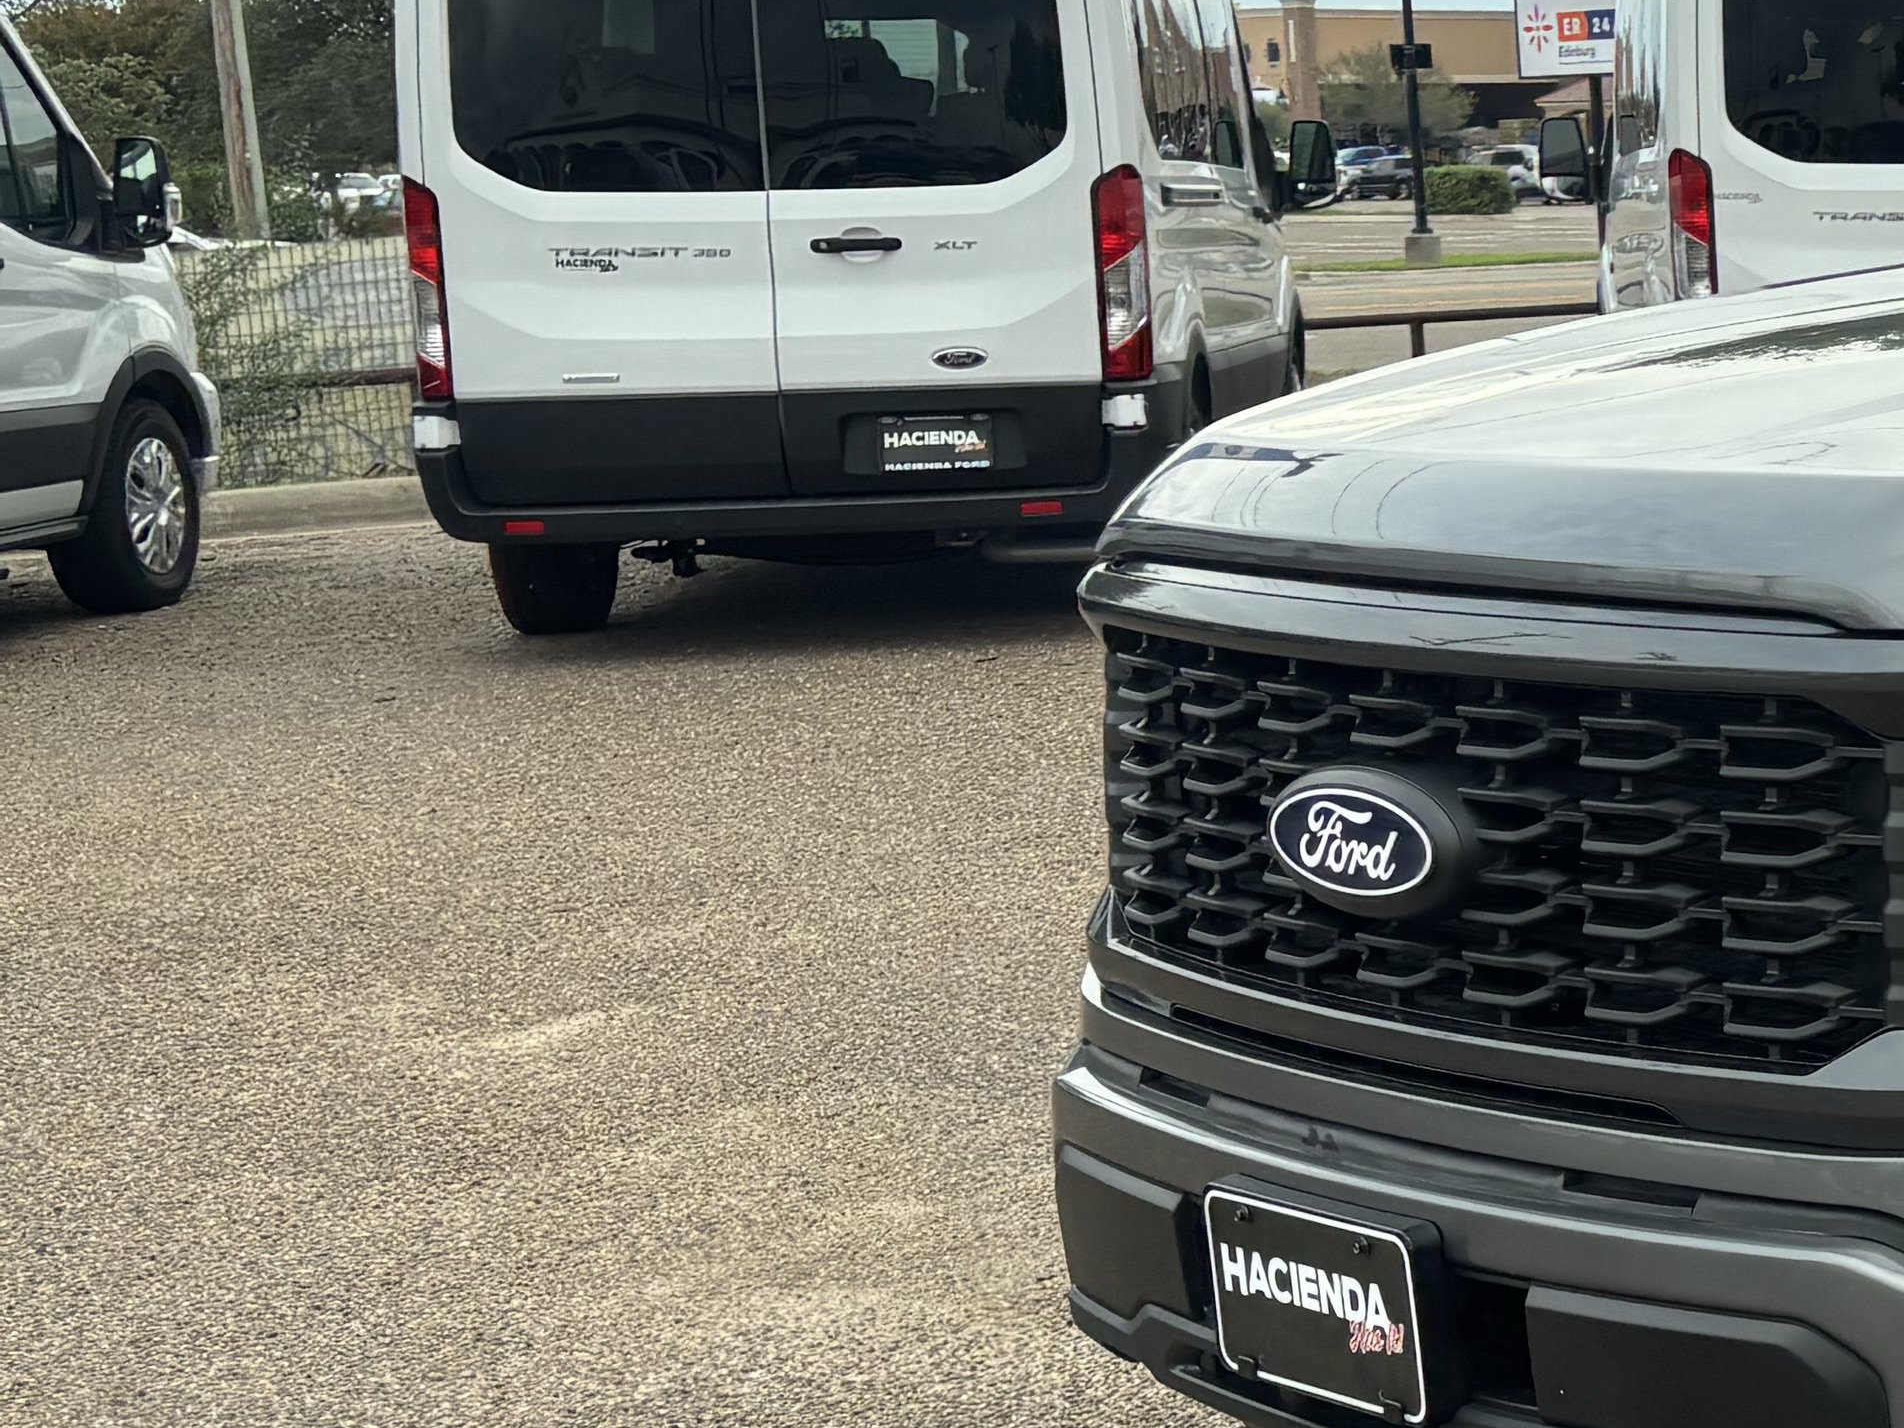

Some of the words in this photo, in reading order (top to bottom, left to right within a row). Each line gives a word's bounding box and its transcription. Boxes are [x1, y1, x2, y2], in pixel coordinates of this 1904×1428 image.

[1562, 17, 1582, 36] ER
[1592, 16, 1611, 34] 24
[548, 246, 689, 258] TRANSIT
[933, 240, 979, 251] XLT
[555, 258, 615, 269] HACIENDA
[883, 430, 982, 449] HACIENDA
[1299, 800, 1400, 882] Ford
[1219, 1242, 1394, 1337] HACIENDA
